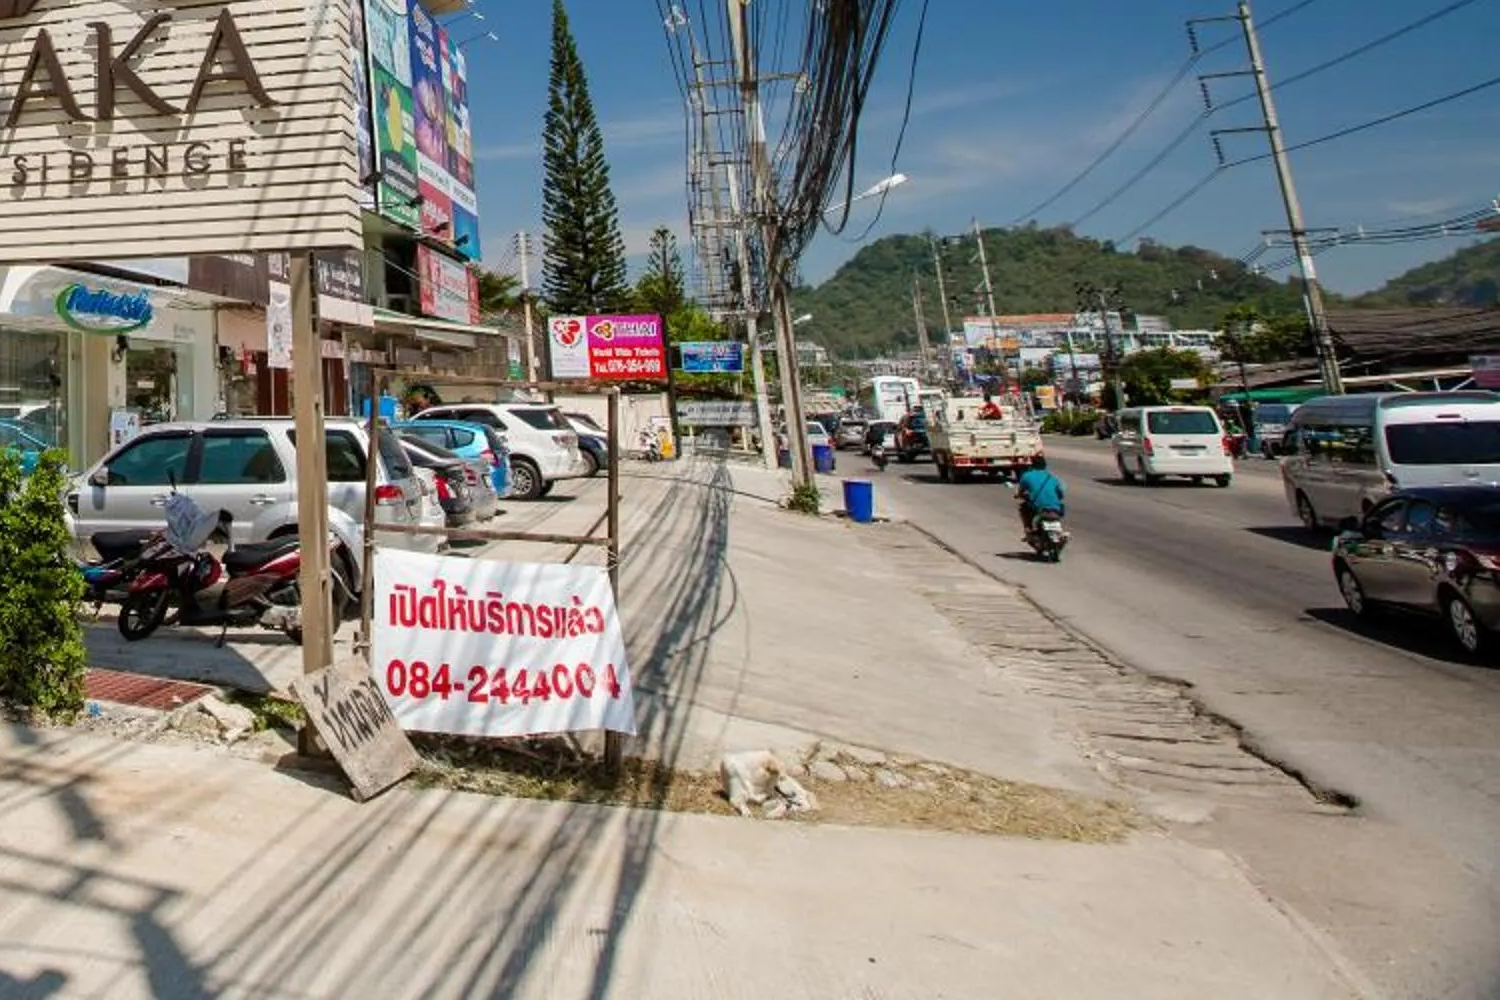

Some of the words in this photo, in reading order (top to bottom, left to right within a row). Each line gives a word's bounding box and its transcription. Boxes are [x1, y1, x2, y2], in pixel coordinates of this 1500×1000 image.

[389, 578, 606, 640] เปิดให้บริการแล้ว
